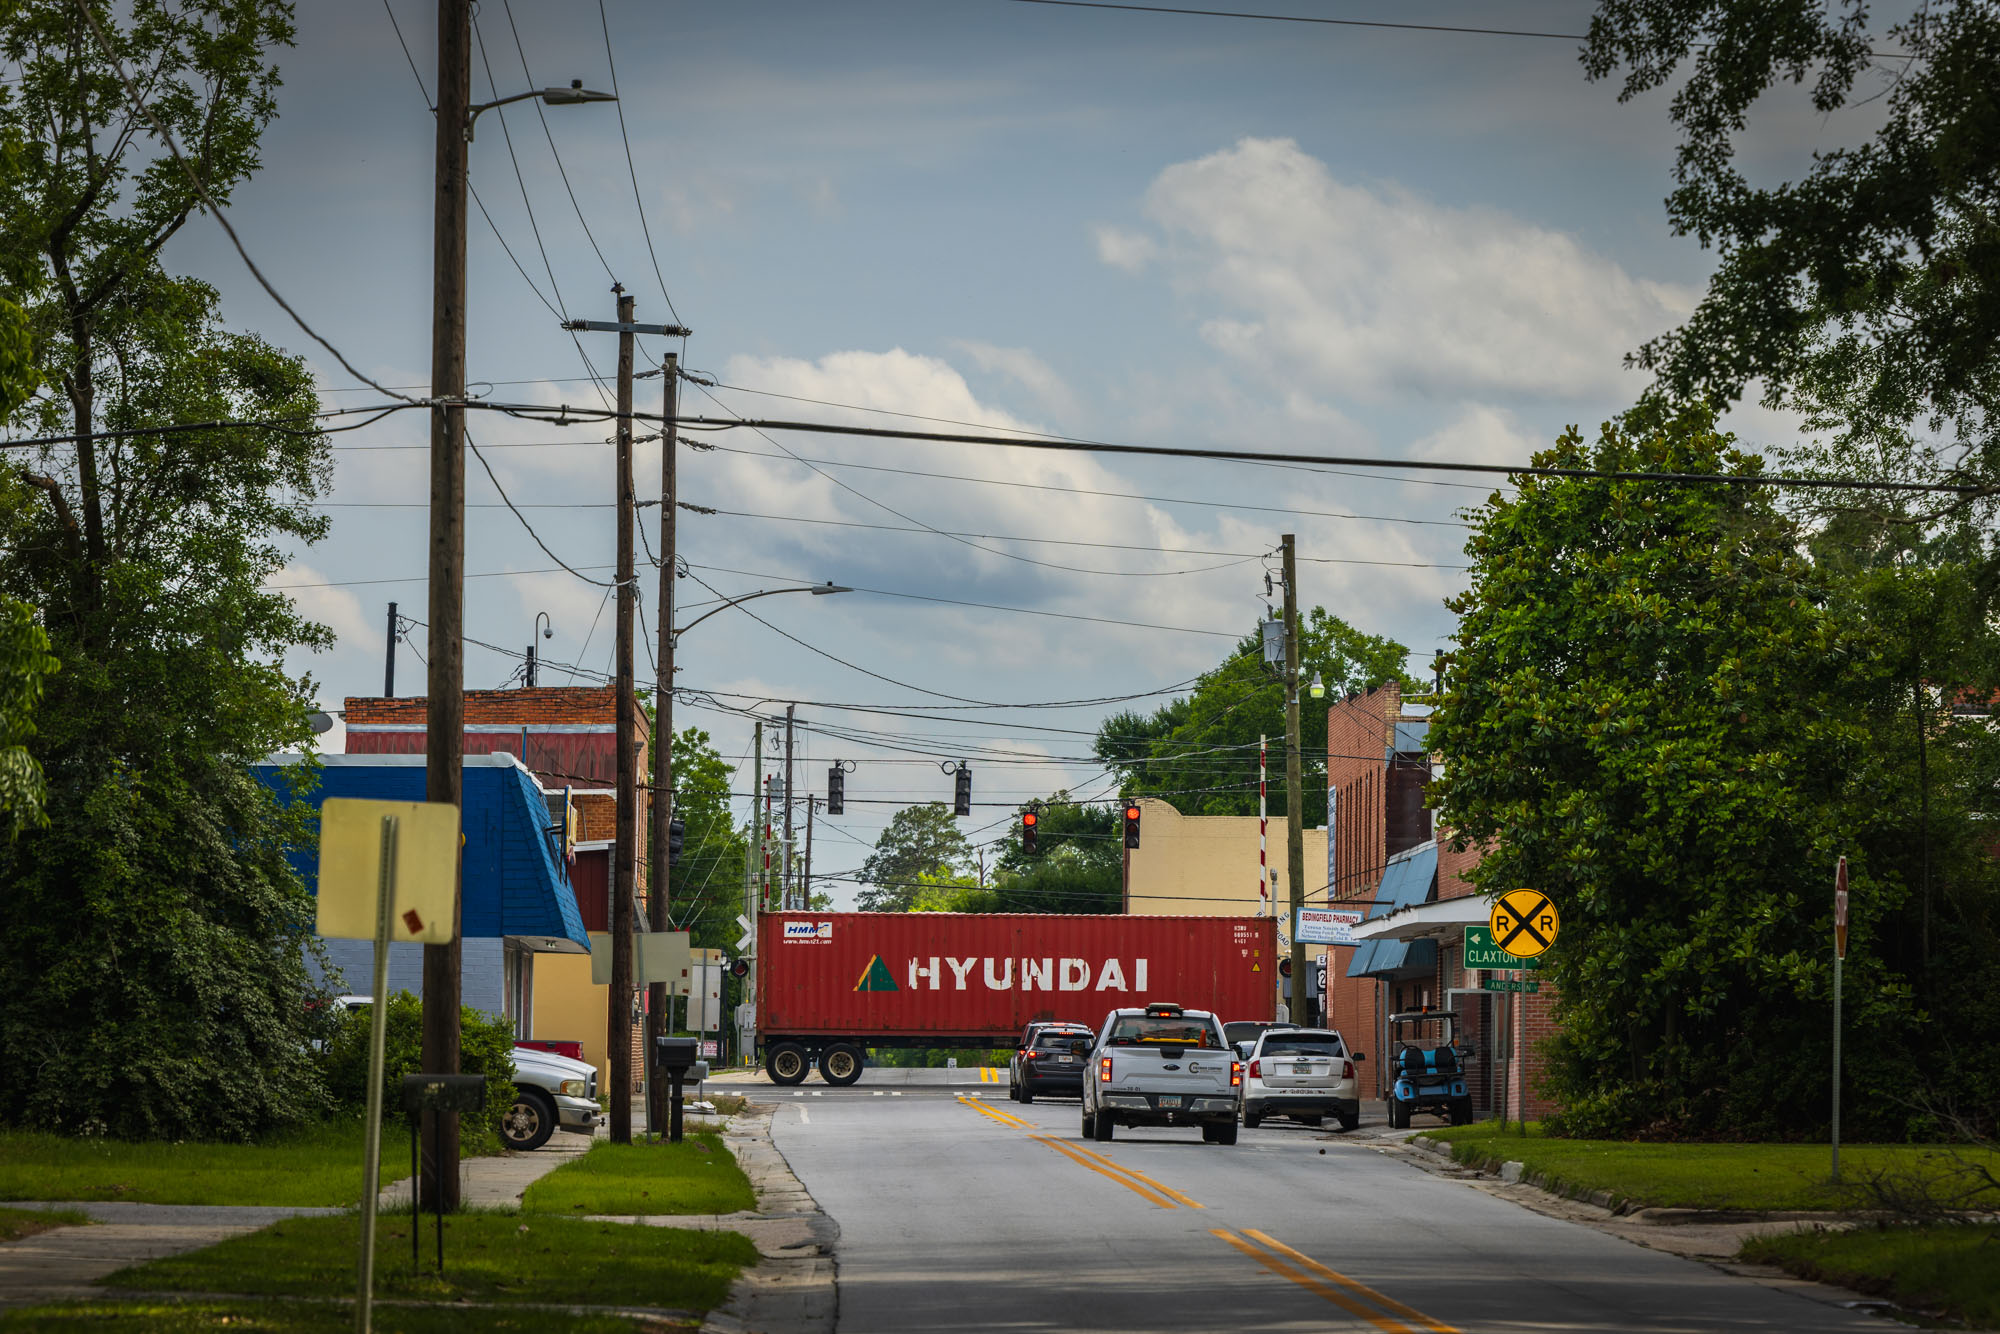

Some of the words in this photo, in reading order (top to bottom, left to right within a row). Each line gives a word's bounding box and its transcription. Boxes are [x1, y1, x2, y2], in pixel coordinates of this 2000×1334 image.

[1302, 912, 1332, 922] BEDINGFIELD
[1333, 914, 1359, 924] PHARMACY
[1496, 916, 1509, 931] R
[1540, 916, 1553, 931] R
[788, 926, 819, 934] HMM
[1468, 950, 1518, 963] CLAXTON
[908, 957, 1148, 992] HYUNDAI
[1490, 981, 1532, 992] ANDERSN
